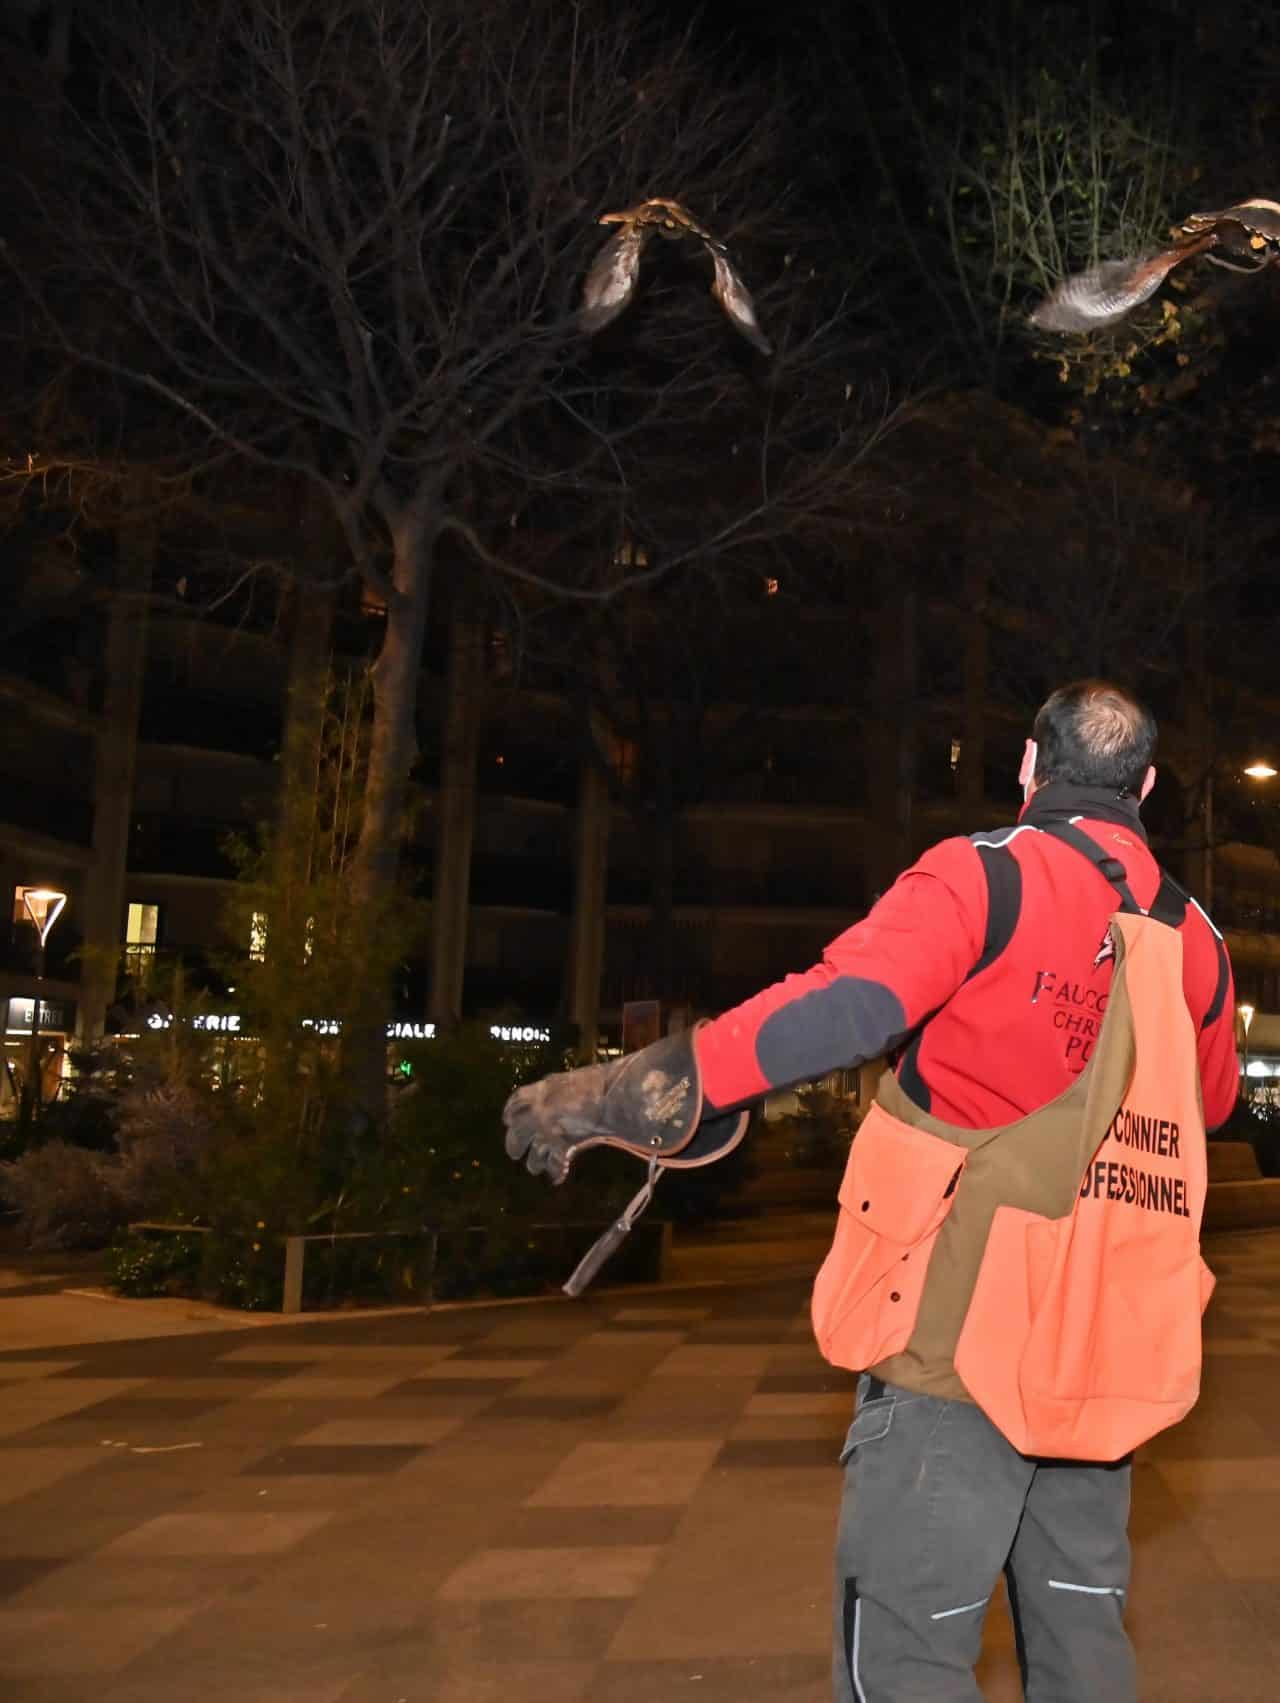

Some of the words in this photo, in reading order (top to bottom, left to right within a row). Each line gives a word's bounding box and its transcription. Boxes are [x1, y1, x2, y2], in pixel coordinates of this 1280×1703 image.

[1053, 1010, 1102, 1037] CHR
[1103, 1105, 1180, 1158] CONNIER
[1080, 1161, 1190, 1218] OFESSIONNEL
